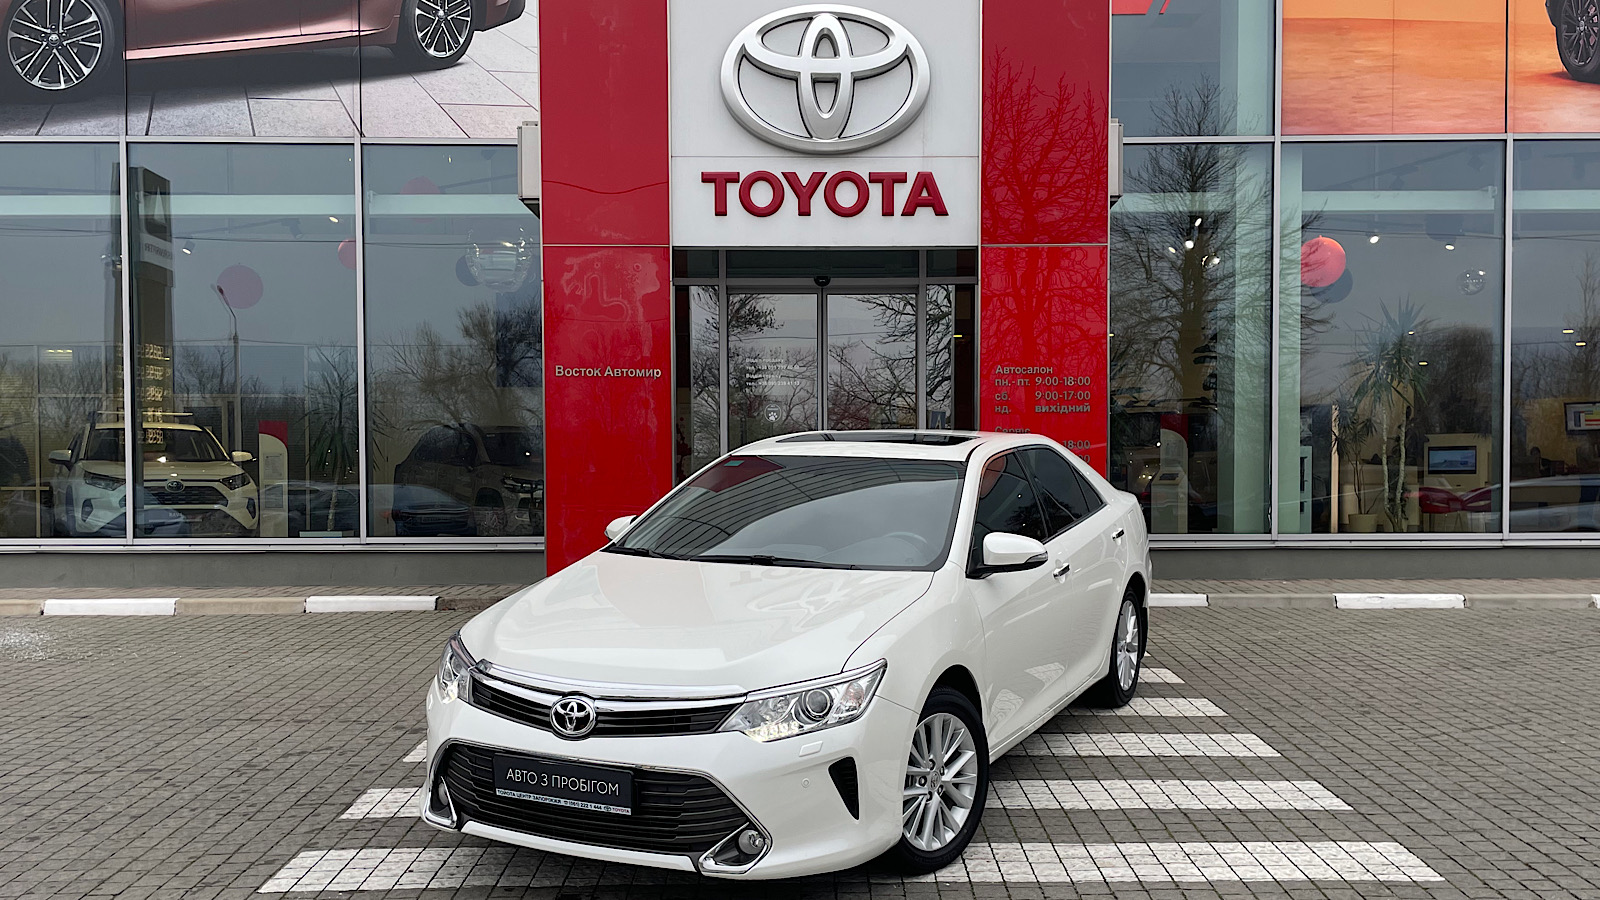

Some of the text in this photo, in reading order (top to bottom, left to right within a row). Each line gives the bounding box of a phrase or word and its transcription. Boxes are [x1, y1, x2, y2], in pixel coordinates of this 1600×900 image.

[701, 170, 949, 217] TOYOTA
[555, 365, 662, 379] Восток Автомир
[995, 365, 1053, 374] Автосалон
[1035, 376, 1091, 386] 9:00-18:00
[995, 391, 1091, 400] сб. 9:00-17:00
[995, 403, 1091, 414] нд. вихідний
[506, 768, 538, 785] АВТО
[551, 775, 619, 796] ПРОБІГОМ
